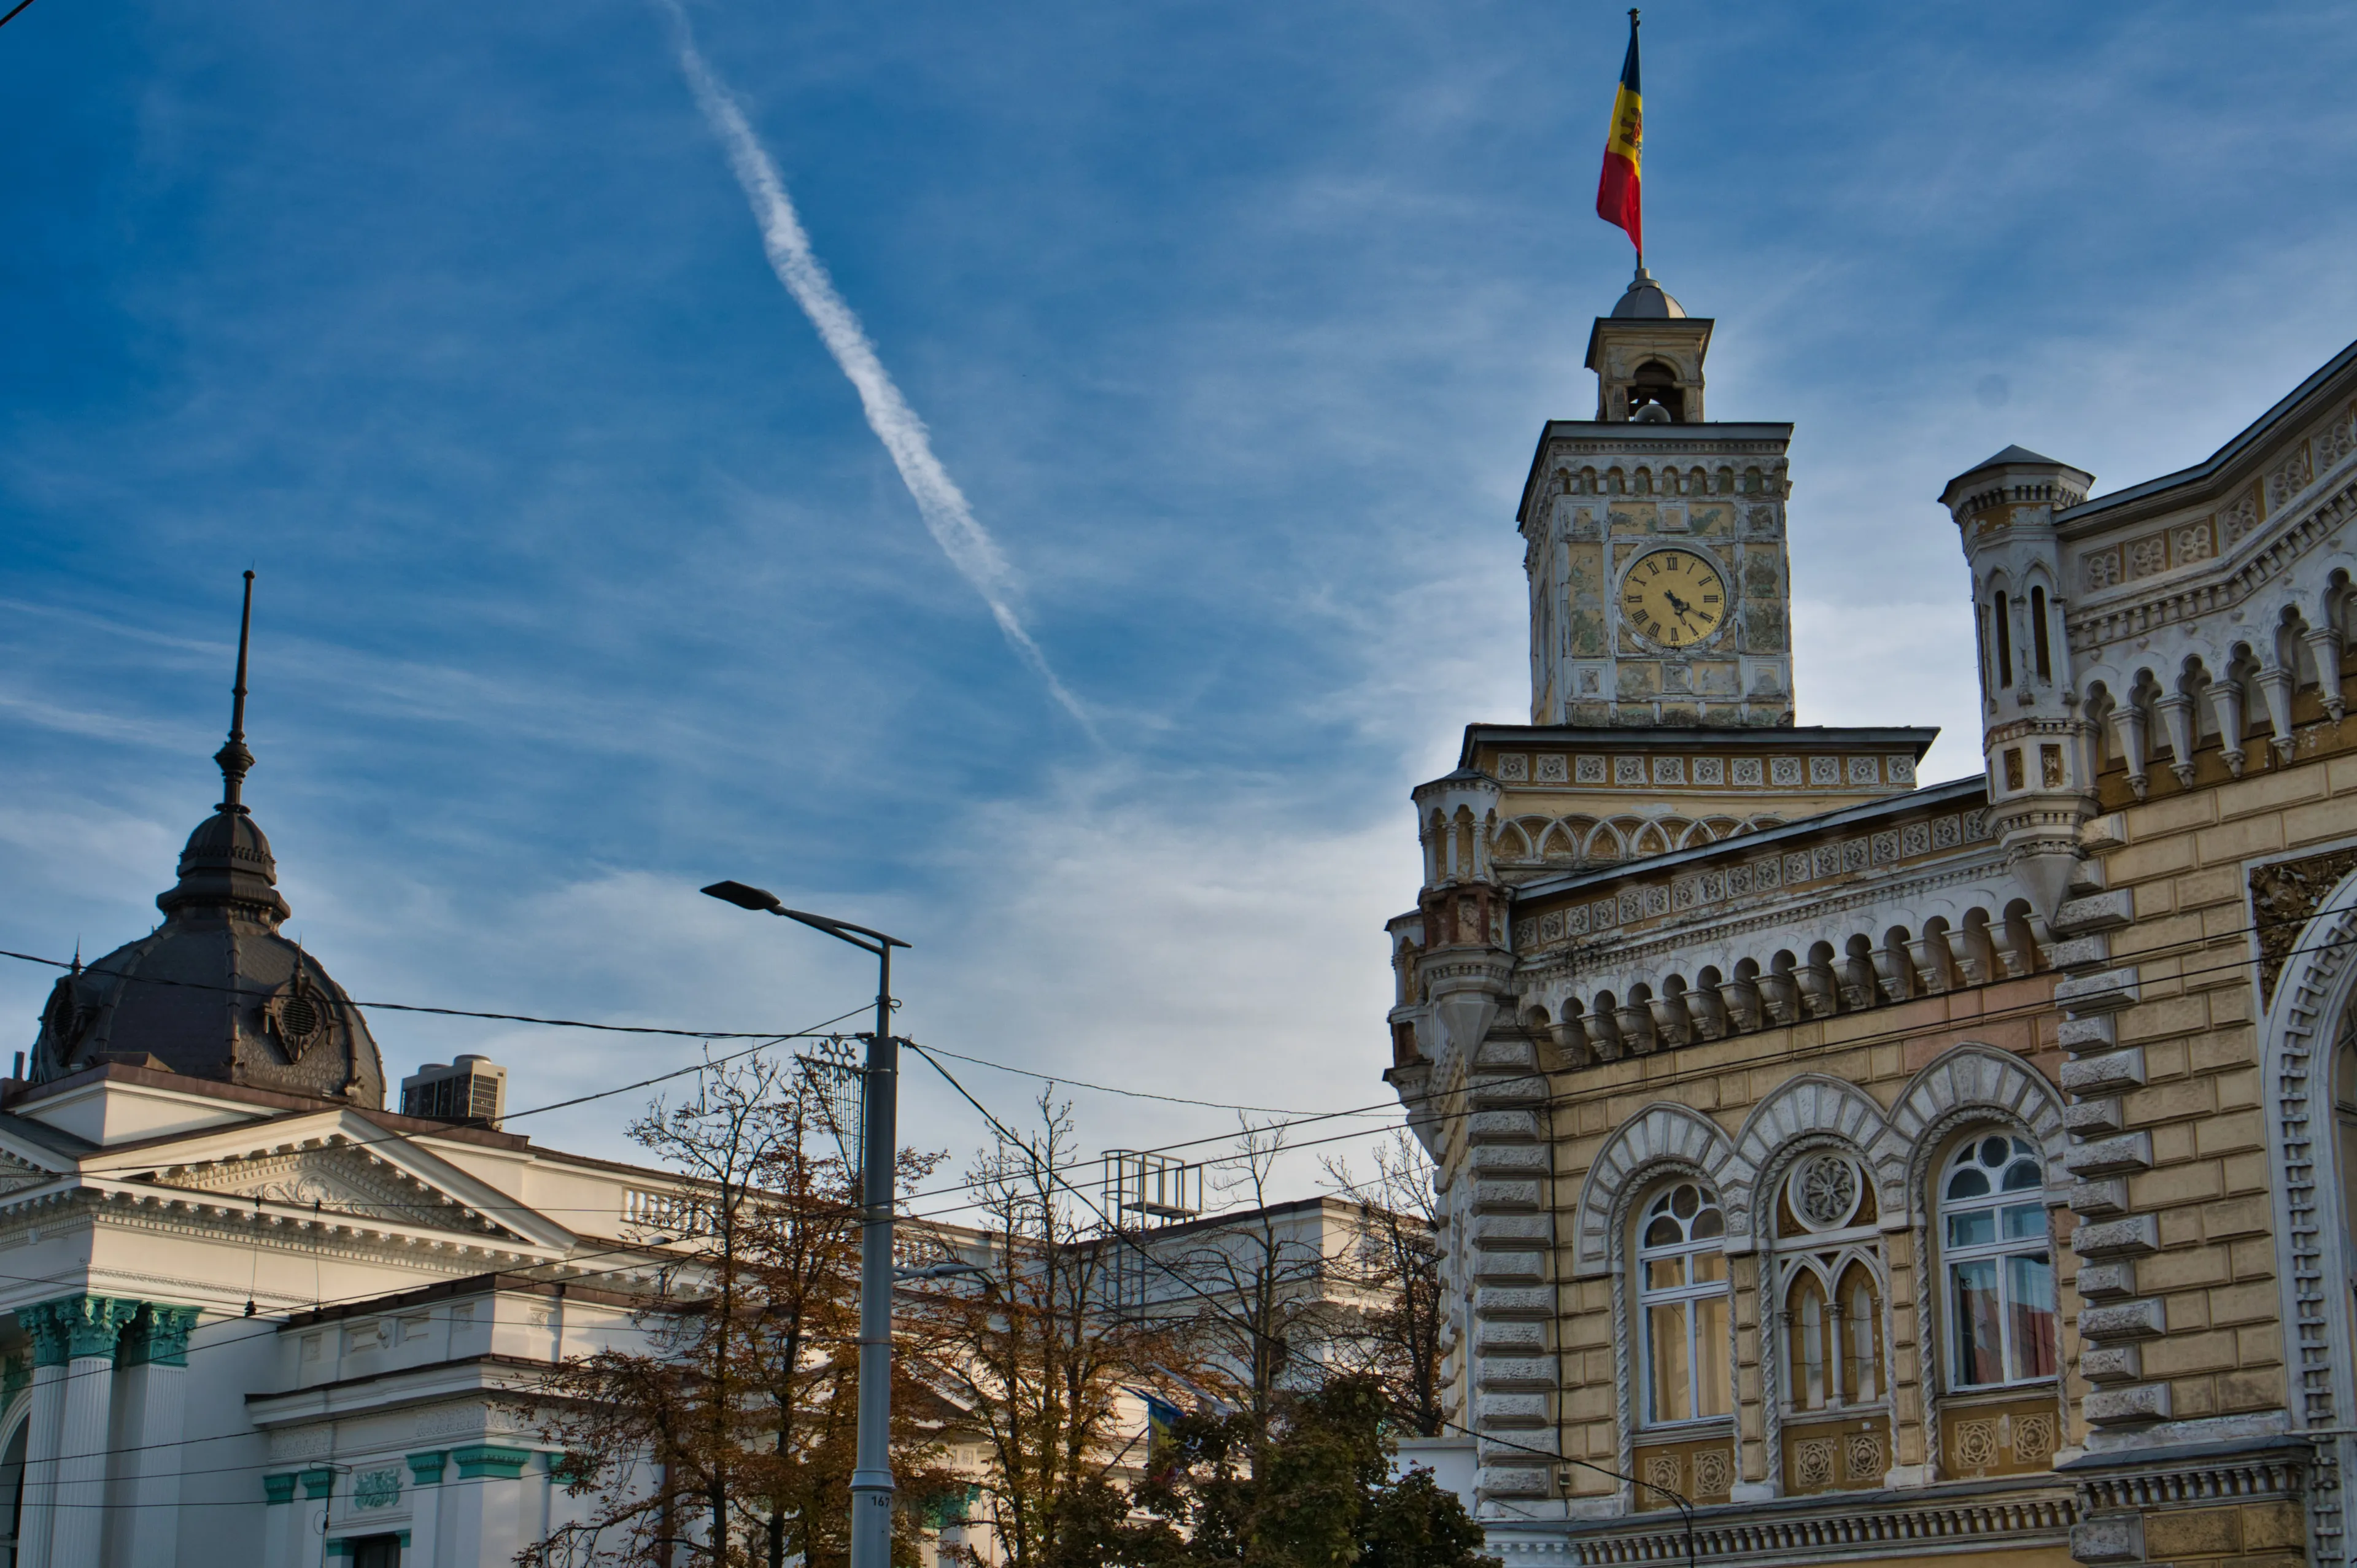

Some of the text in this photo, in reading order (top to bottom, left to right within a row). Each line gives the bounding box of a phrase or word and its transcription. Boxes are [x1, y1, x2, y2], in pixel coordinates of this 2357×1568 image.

[1646, 561, 1660, 576] XI
[1666, 557, 1678, 571] XII
[1632, 576, 1646, 587] X
[1628, 595, 1643, 603] IX
[1703, 595, 1718, 603] III
